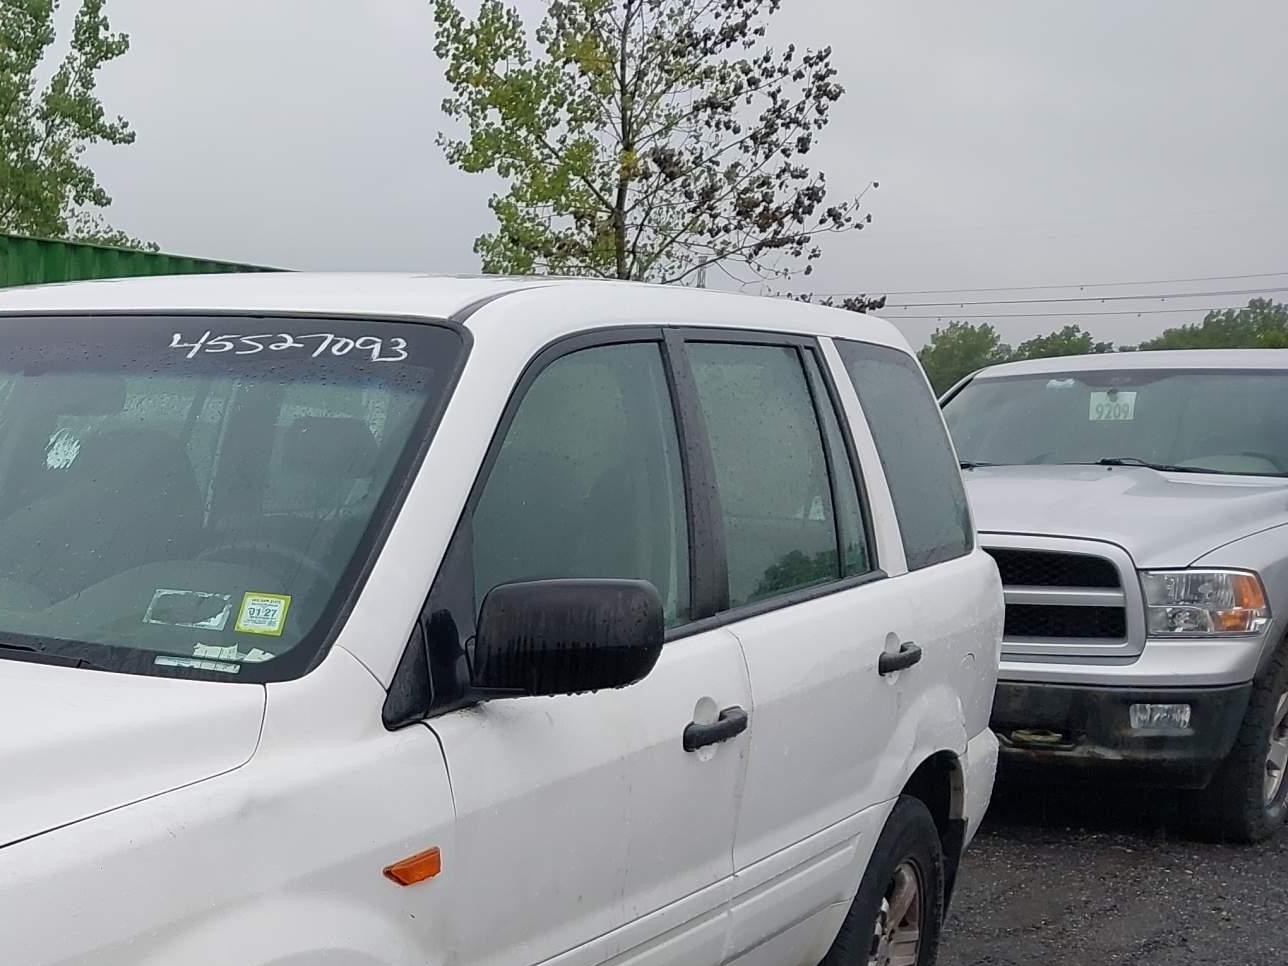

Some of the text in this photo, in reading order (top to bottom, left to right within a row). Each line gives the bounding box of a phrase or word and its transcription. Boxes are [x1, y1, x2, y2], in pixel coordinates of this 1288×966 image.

[169, 330, 408, 361] 45527093
[1095, 402, 1130, 419] 9209
[264, 608, 278, 617] 27
